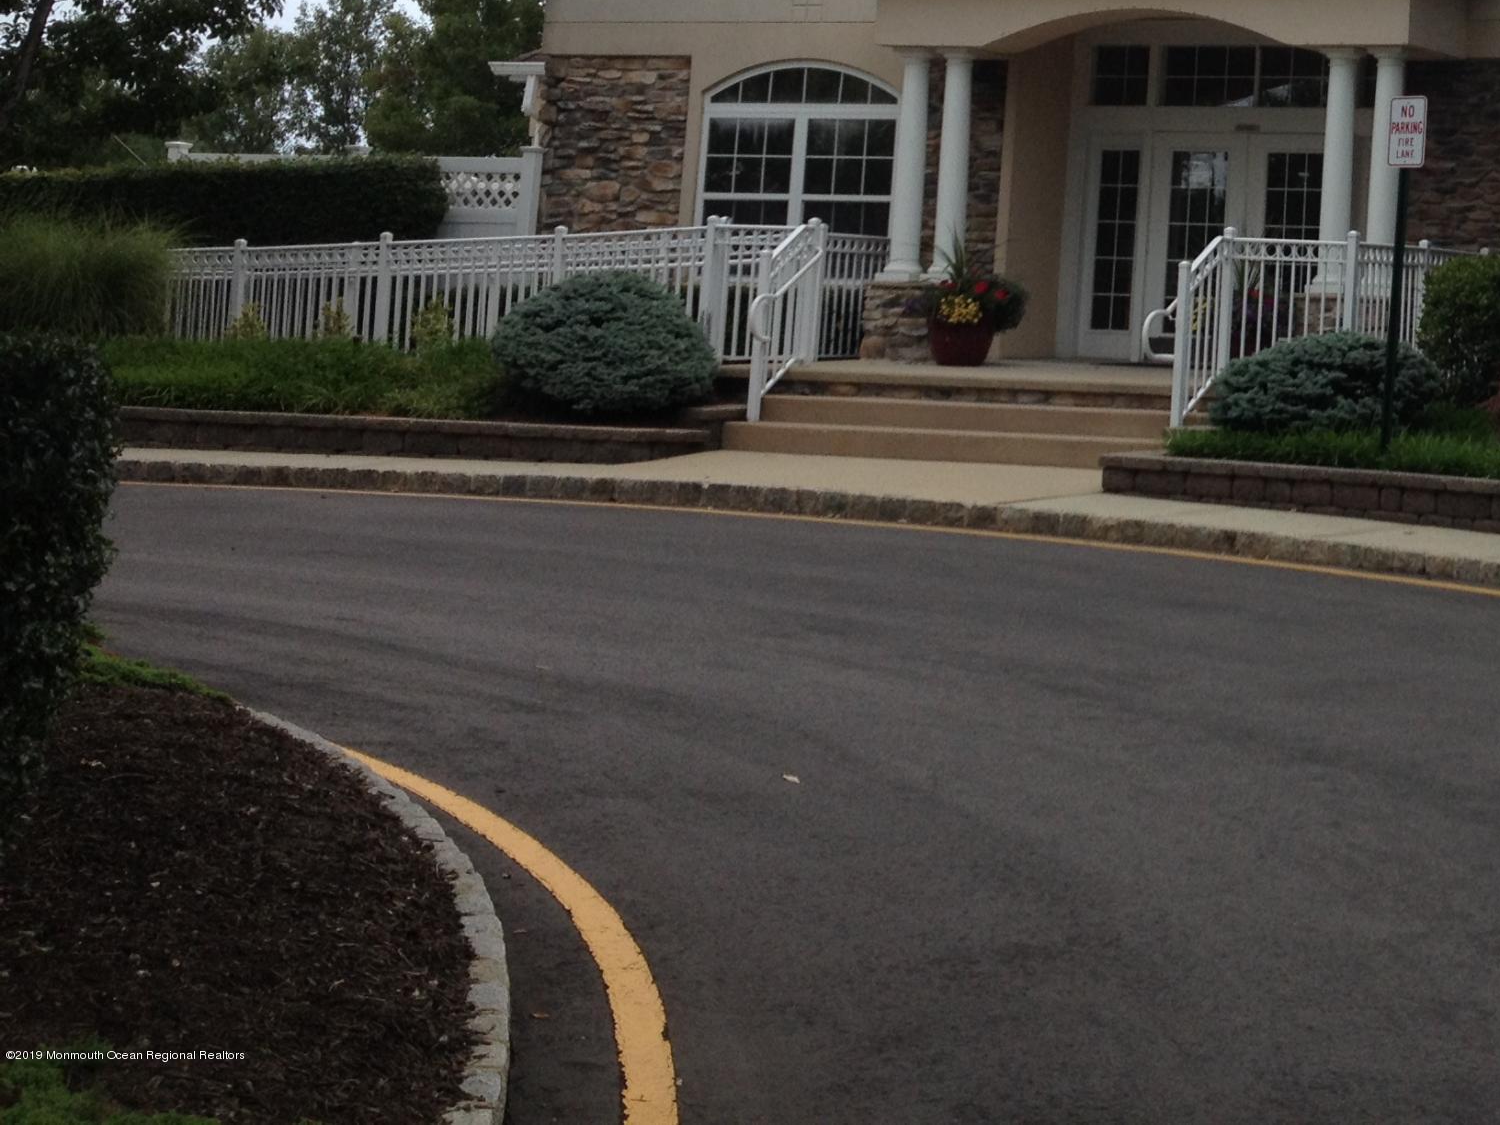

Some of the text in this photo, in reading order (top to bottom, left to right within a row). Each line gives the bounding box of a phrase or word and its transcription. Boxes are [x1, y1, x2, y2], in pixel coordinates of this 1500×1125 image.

[1401, 105, 1415, 118] NO
[1391, 121, 1424, 135] PARKING
[1398, 137, 1415, 147] FIRE
[1396, 150, 1415, 159] LANE
